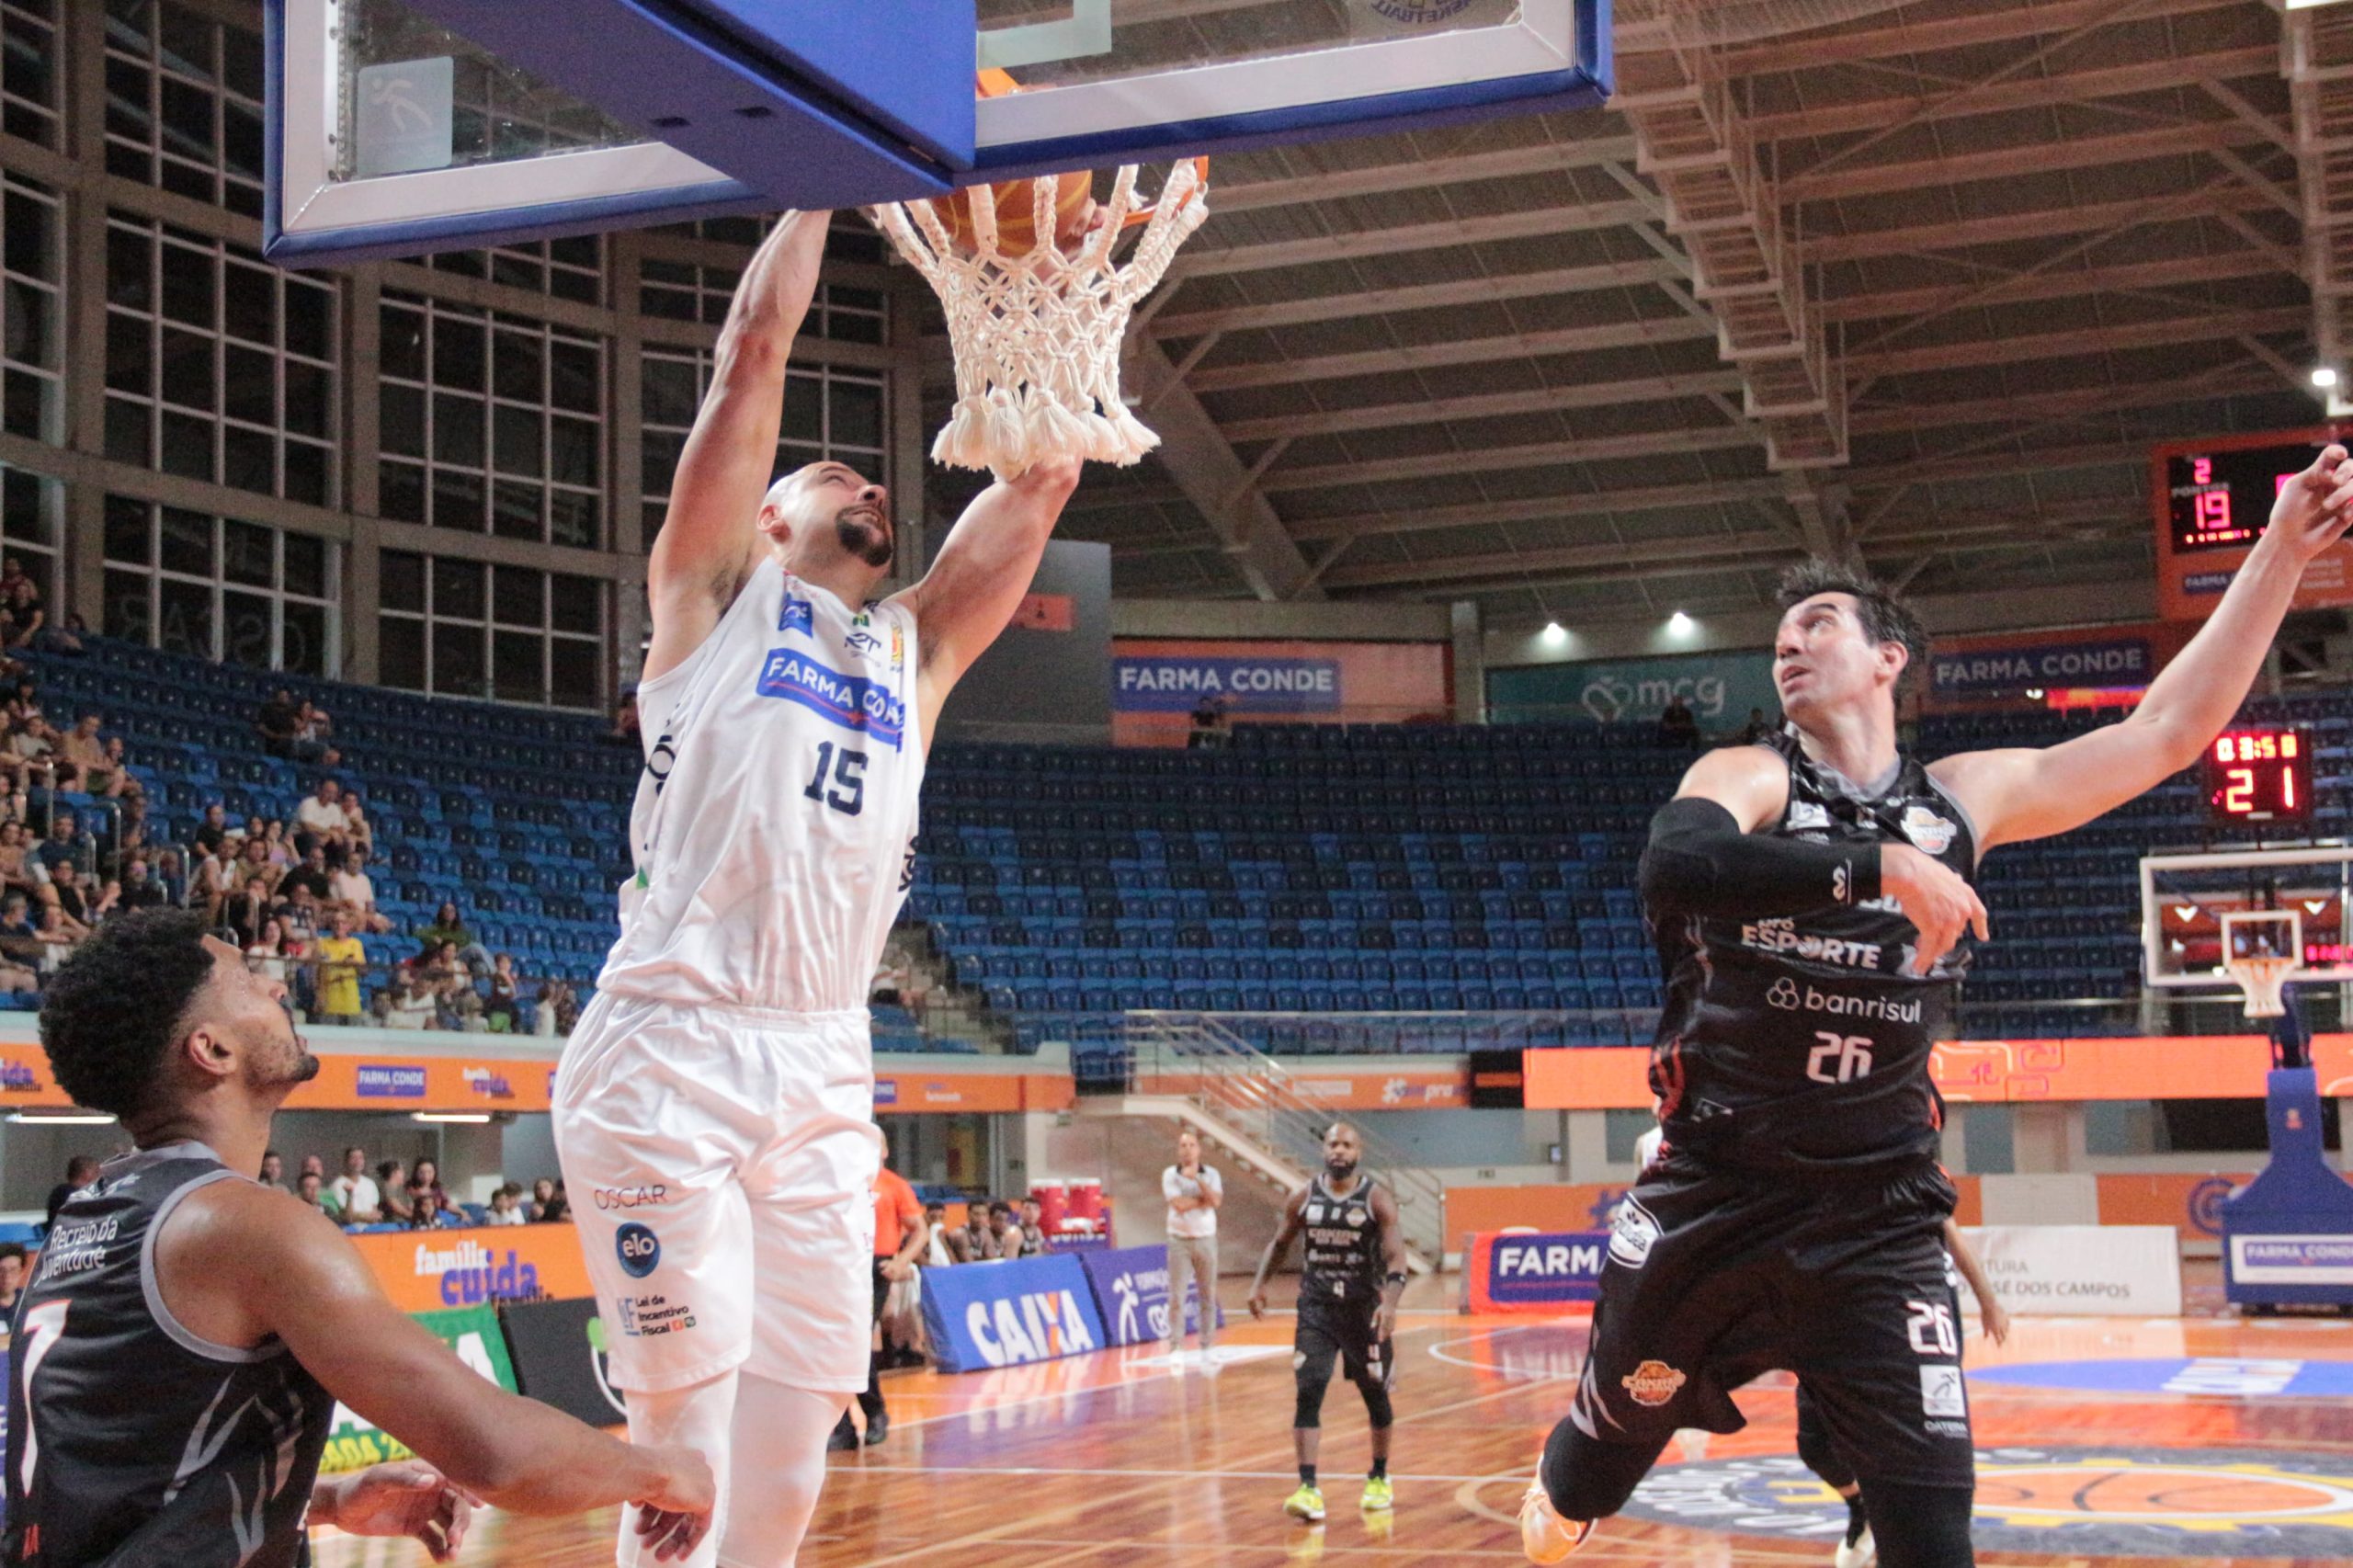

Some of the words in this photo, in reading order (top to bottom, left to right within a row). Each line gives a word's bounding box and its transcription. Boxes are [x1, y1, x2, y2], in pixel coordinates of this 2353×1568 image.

[2196, 491, 2231, 529] 19
[767, 656, 854, 708] FARMA
[1120, 666, 1222, 690] FARMA
[1231, 667, 1334, 692] CONDE
[1937, 657, 2033, 685] FARMA
[2041, 647, 2143, 676] CONDE
[1638, 676, 1725, 717] mcg
[803, 740, 869, 817] 15
[1805, 984, 1921, 1024] banrisul
[1806, 1030, 1874, 1085] 26
[595, 1185, 667, 1210] OSCAR
[622, 1233, 655, 1258] elo
[1498, 1244, 1607, 1277] FARM
[2246, 1244, 2301, 1259] FARMA
[440, 1250, 539, 1306] cuida
[2015, 1280, 2052, 1298] DOS
[2055, 1281, 2131, 1300] CAMPOS
[638, 1305, 689, 1322] Incentivo
[642, 1323, 671, 1336] Fiscal
[968, 1290, 1094, 1367] CAIXA
[1906, 1301, 1958, 1356] 26
[20, 1298, 74, 1499] 7
